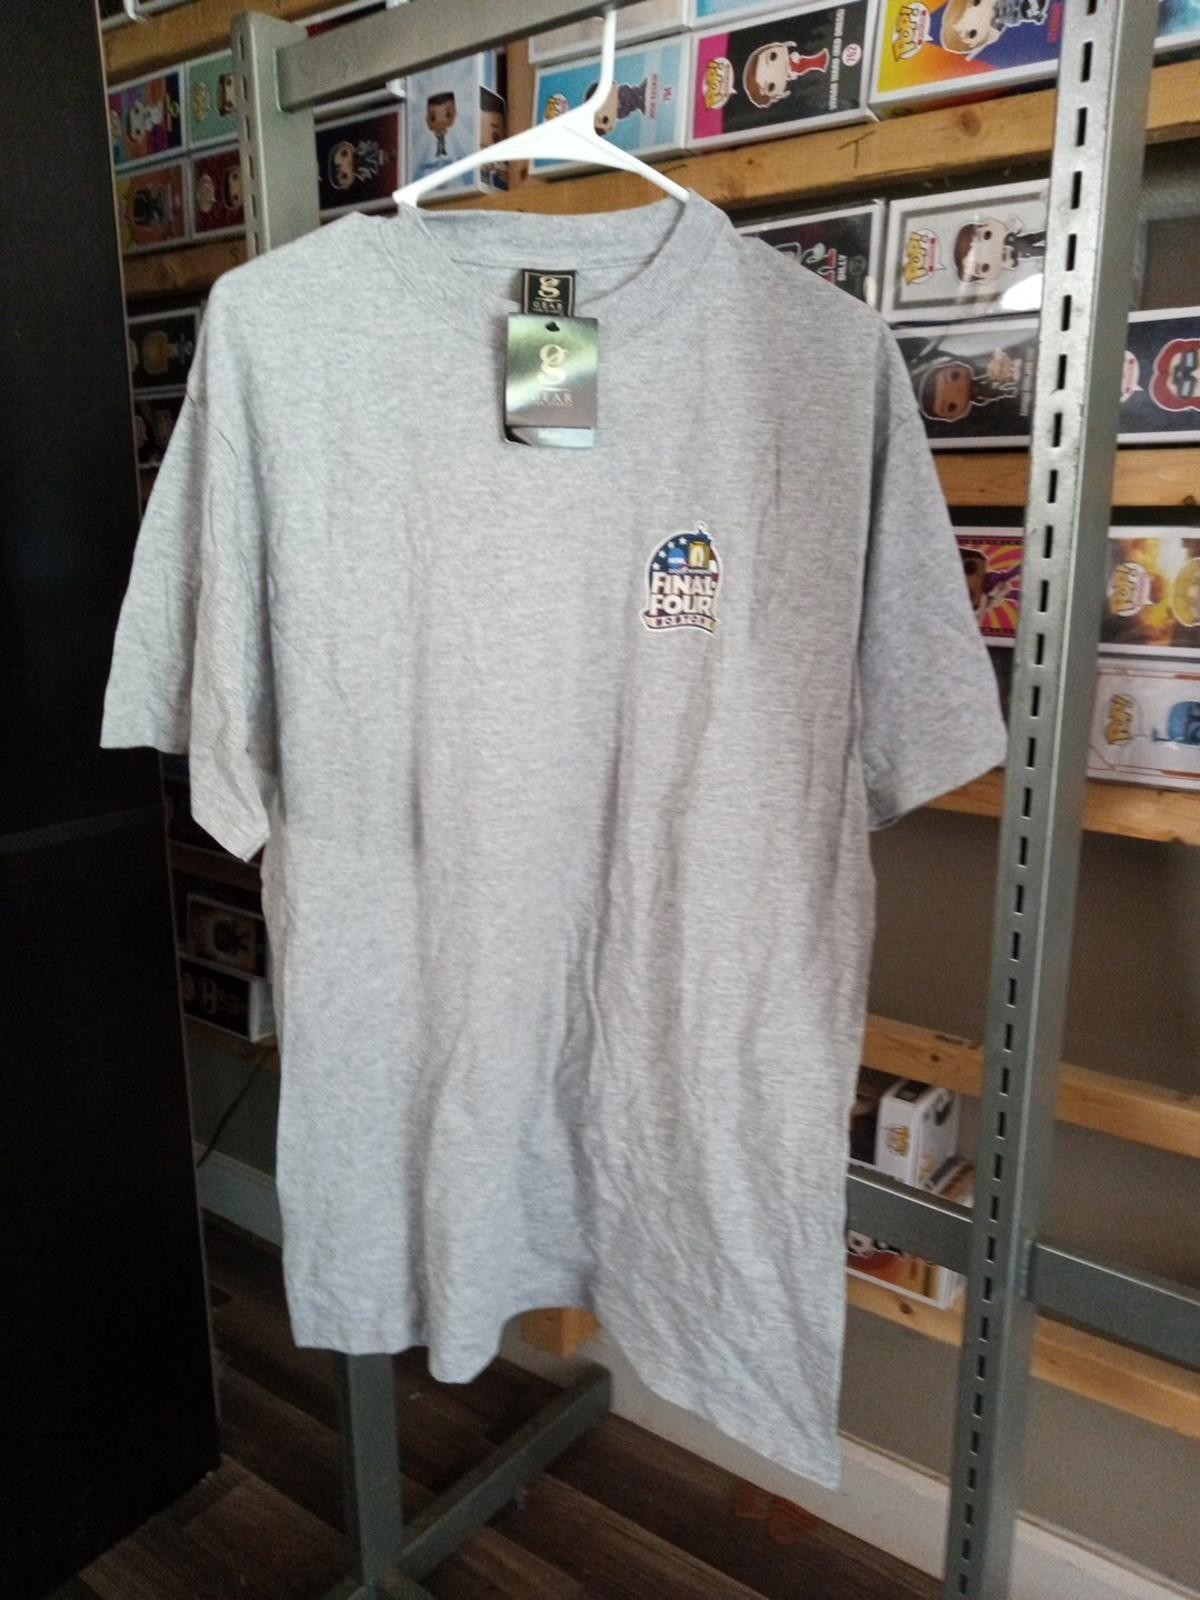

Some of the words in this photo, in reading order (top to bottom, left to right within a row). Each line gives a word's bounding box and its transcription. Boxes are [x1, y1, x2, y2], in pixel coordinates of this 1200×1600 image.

[893, 6, 919, 62] POP!
[703, 58, 724, 111] POP!
[837, 254, 848, 282] BILLY
[902, 231, 929, 285] POP!
[652, 572, 713, 597] FINAL
[649, 594, 714, 618] FOUR
